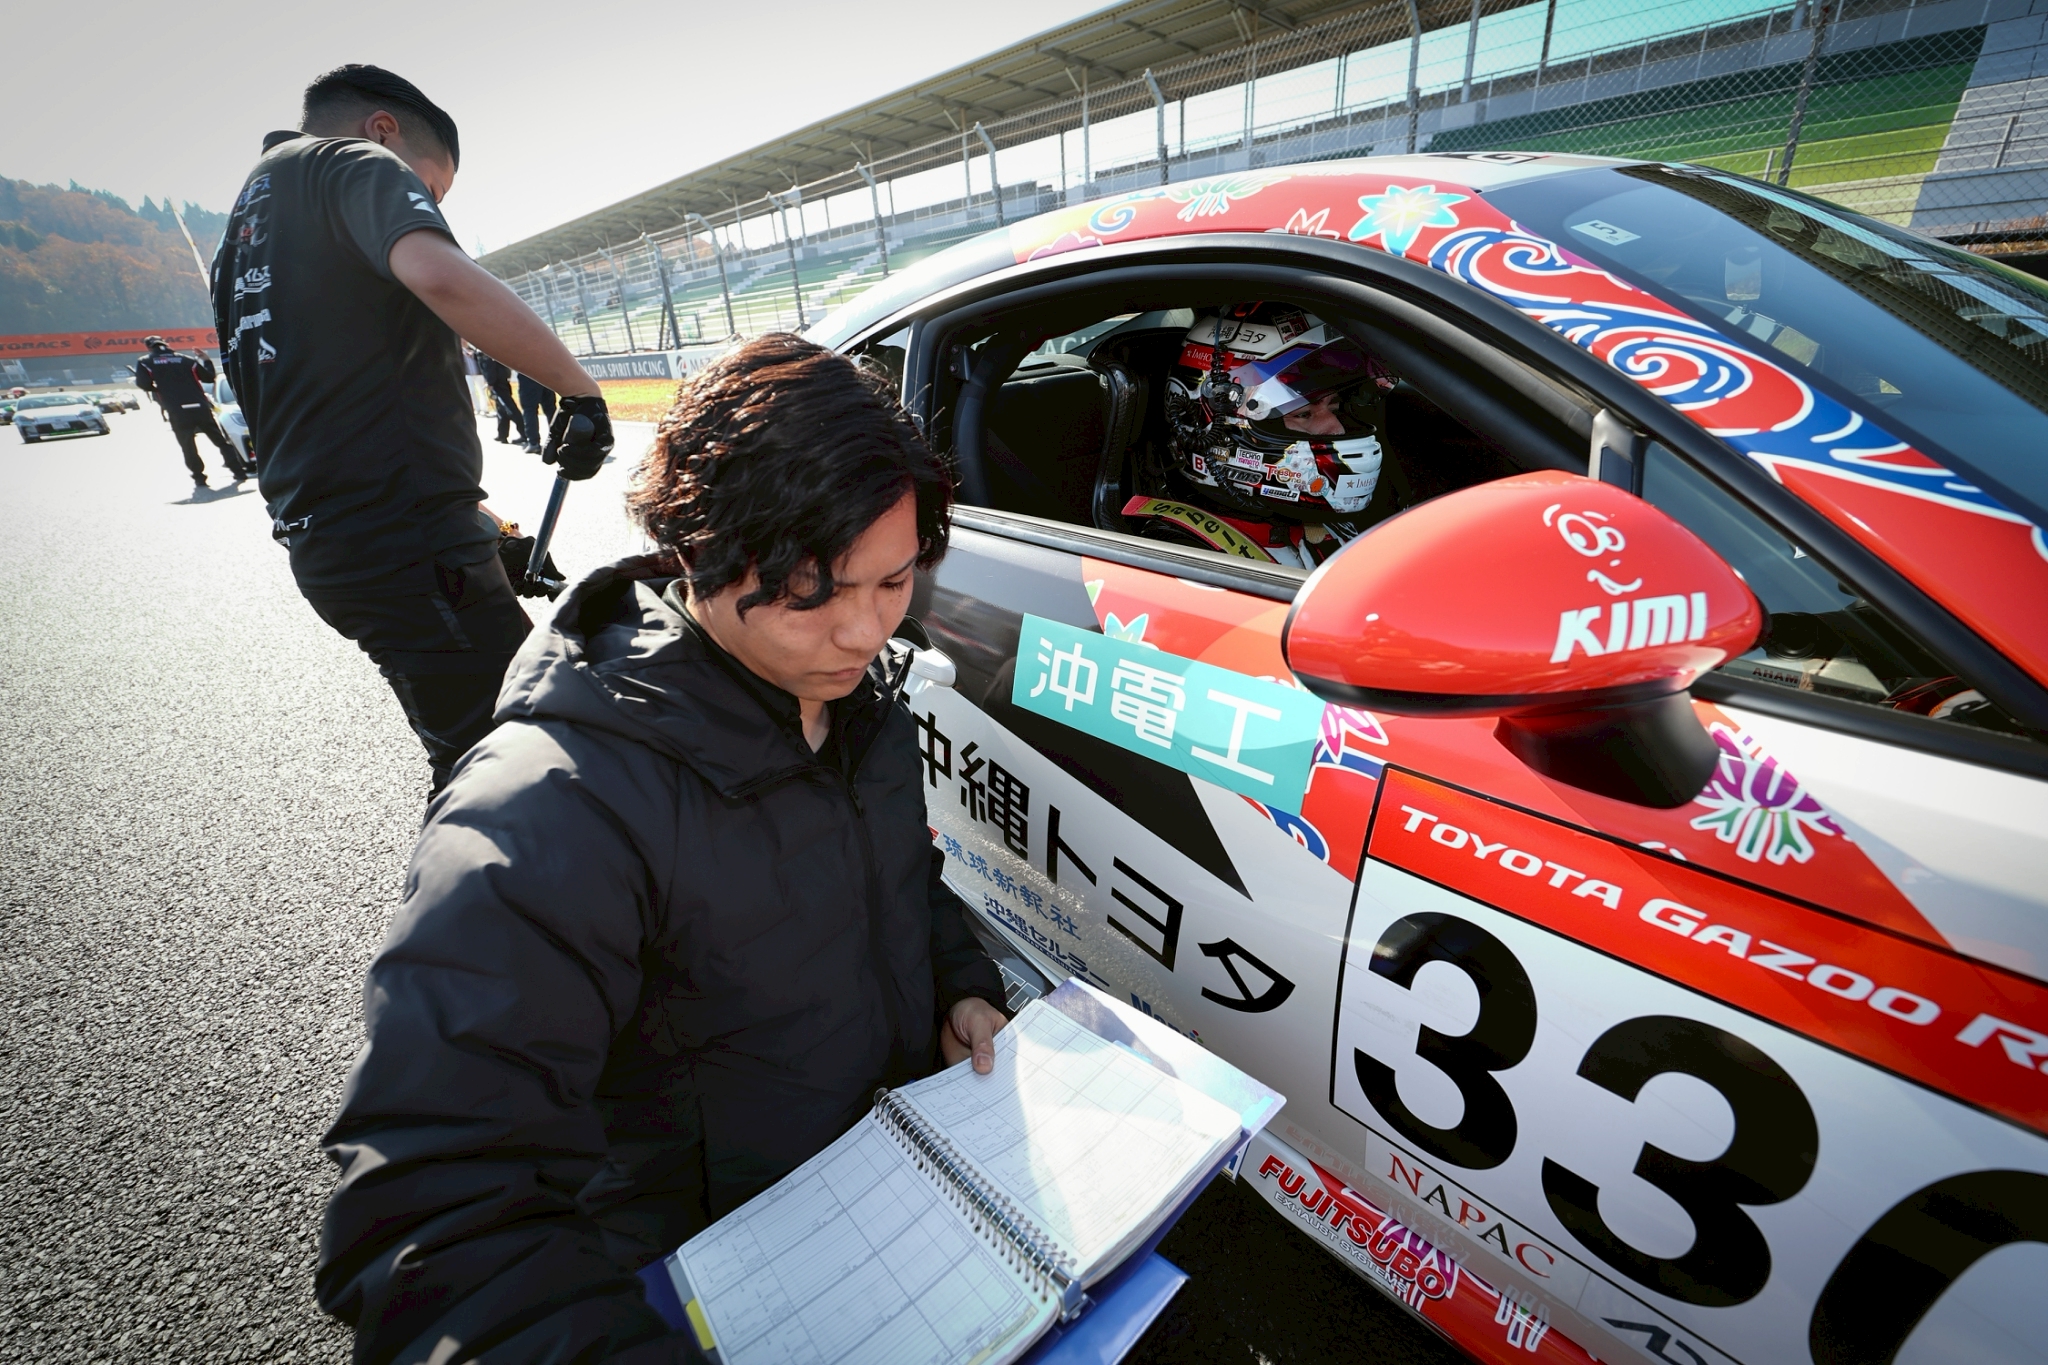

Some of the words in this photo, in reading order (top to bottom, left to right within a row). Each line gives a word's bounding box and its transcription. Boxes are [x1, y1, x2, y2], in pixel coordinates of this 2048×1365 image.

[607, 361, 631, 378] SPIRIT
[632, 360, 665, 376] RACING
[1206, 325, 1267, 344] 縄ヨタ
[1152, 502, 1256, 560] Sabelt
[1549, 592, 1708, 664] KIMI
[1029, 637, 1283, 787] 沖電工
[942, 832, 1082, 941] 琉球新報社
[983, 891, 1111, 988] 沖縄セルラー
[1401, 804, 1626, 910] TOYOTA
[1638, 898, 1942, 1026] GAZOO
[1953, 1012, 2048, 1076] R
[1258, 1154, 1447, 1299] FUJITSUBO
[1274, 1191, 1339, 1242] EXHAUST
[1340, 1239, 1409, 1295] SYSTEMS
[1387, 1153, 1556, 1279] NAPAC
